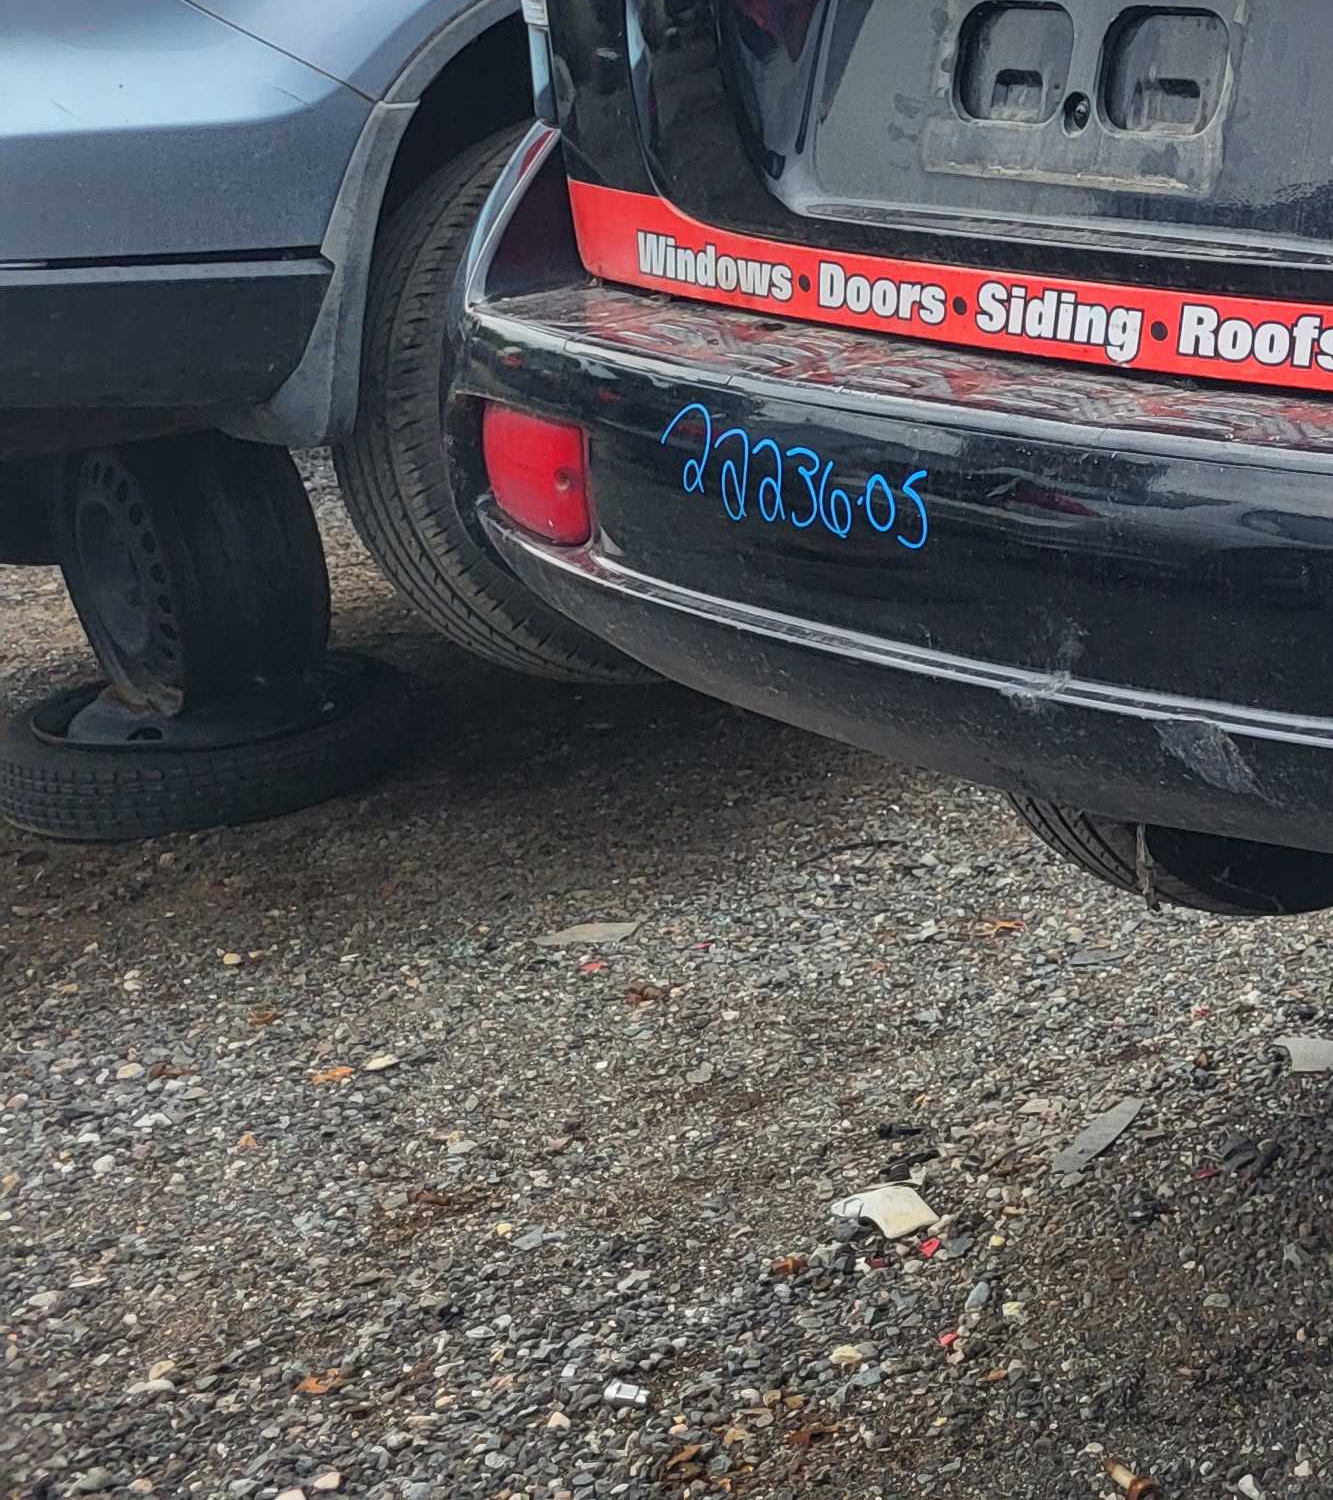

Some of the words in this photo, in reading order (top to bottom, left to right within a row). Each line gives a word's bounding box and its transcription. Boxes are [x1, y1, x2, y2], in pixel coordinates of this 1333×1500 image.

[636, 229, 793, 302] Windows
[817, 260, 947, 325] Doors
[975, 281, 1144, 364] Siding
